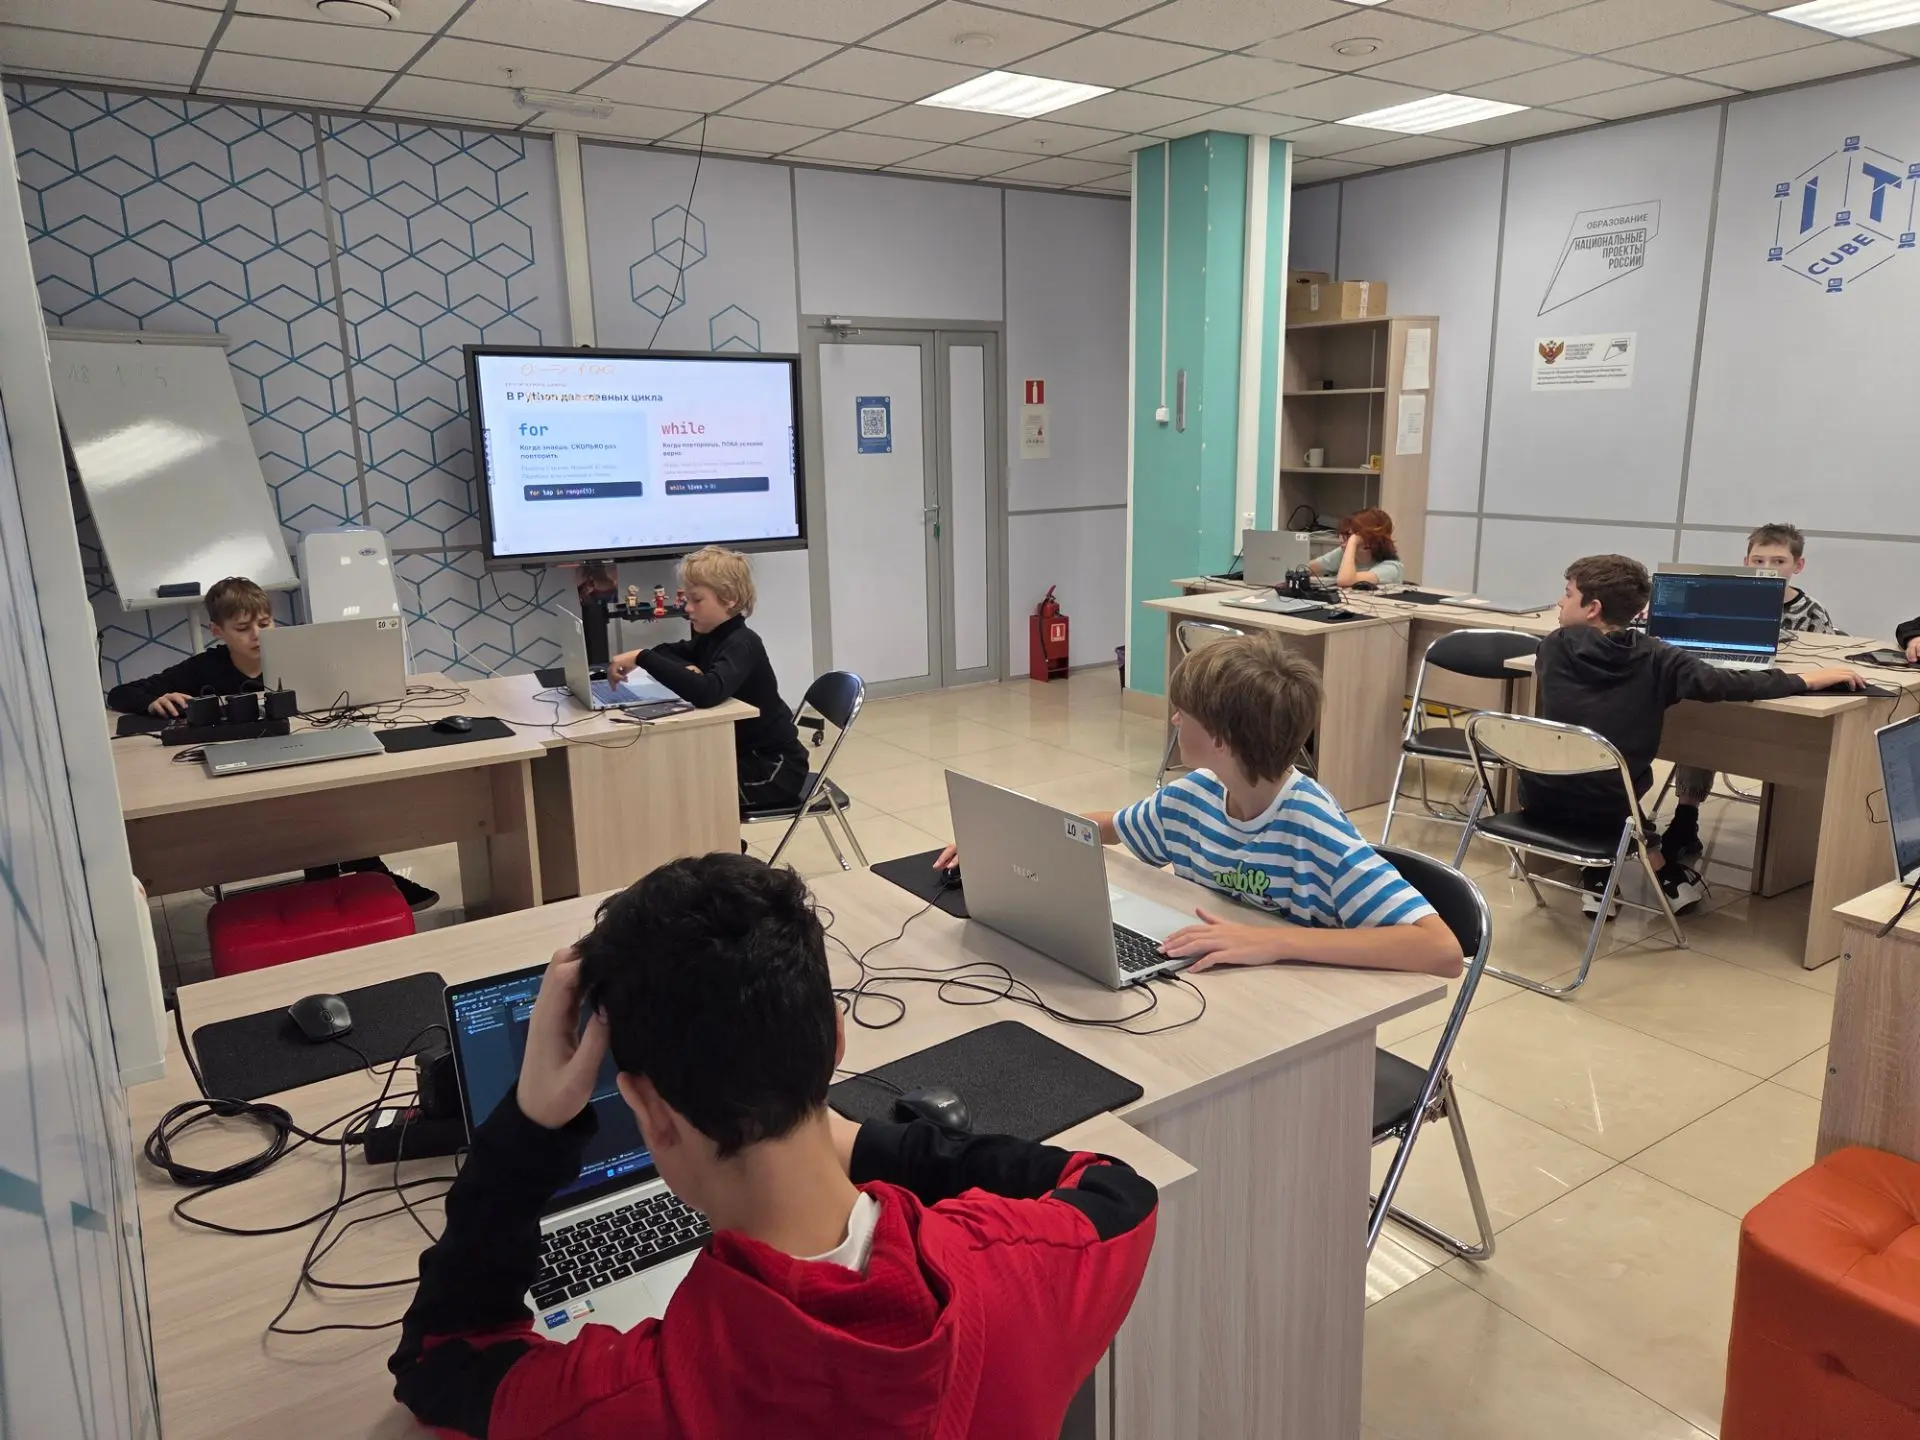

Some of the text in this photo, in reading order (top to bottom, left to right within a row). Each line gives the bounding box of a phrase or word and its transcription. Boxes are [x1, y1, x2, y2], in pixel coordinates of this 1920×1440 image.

[1586, 213, 1649, 229] ОБРАЗОВАНИЕ
[1574, 231, 1643, 250] НАЦИОНАЛЬНЫЕ
[1602, 243, 1642, 259] ПРОЕКТЫ
[1807, 233, 1875, 275] CUBE
[1608, 256, 1642, 269] РОССИИ
[506, 391, 515, 401] В
[517, 391, 559, 403] Python
[631, 394, 663, 402] цикла
[518, 422, 549, 437] for
[661, 421, 705, 435] while
[571, 443, 603, 451] СКОЛЬКО
[1067, 823, 1077, 837] 07
